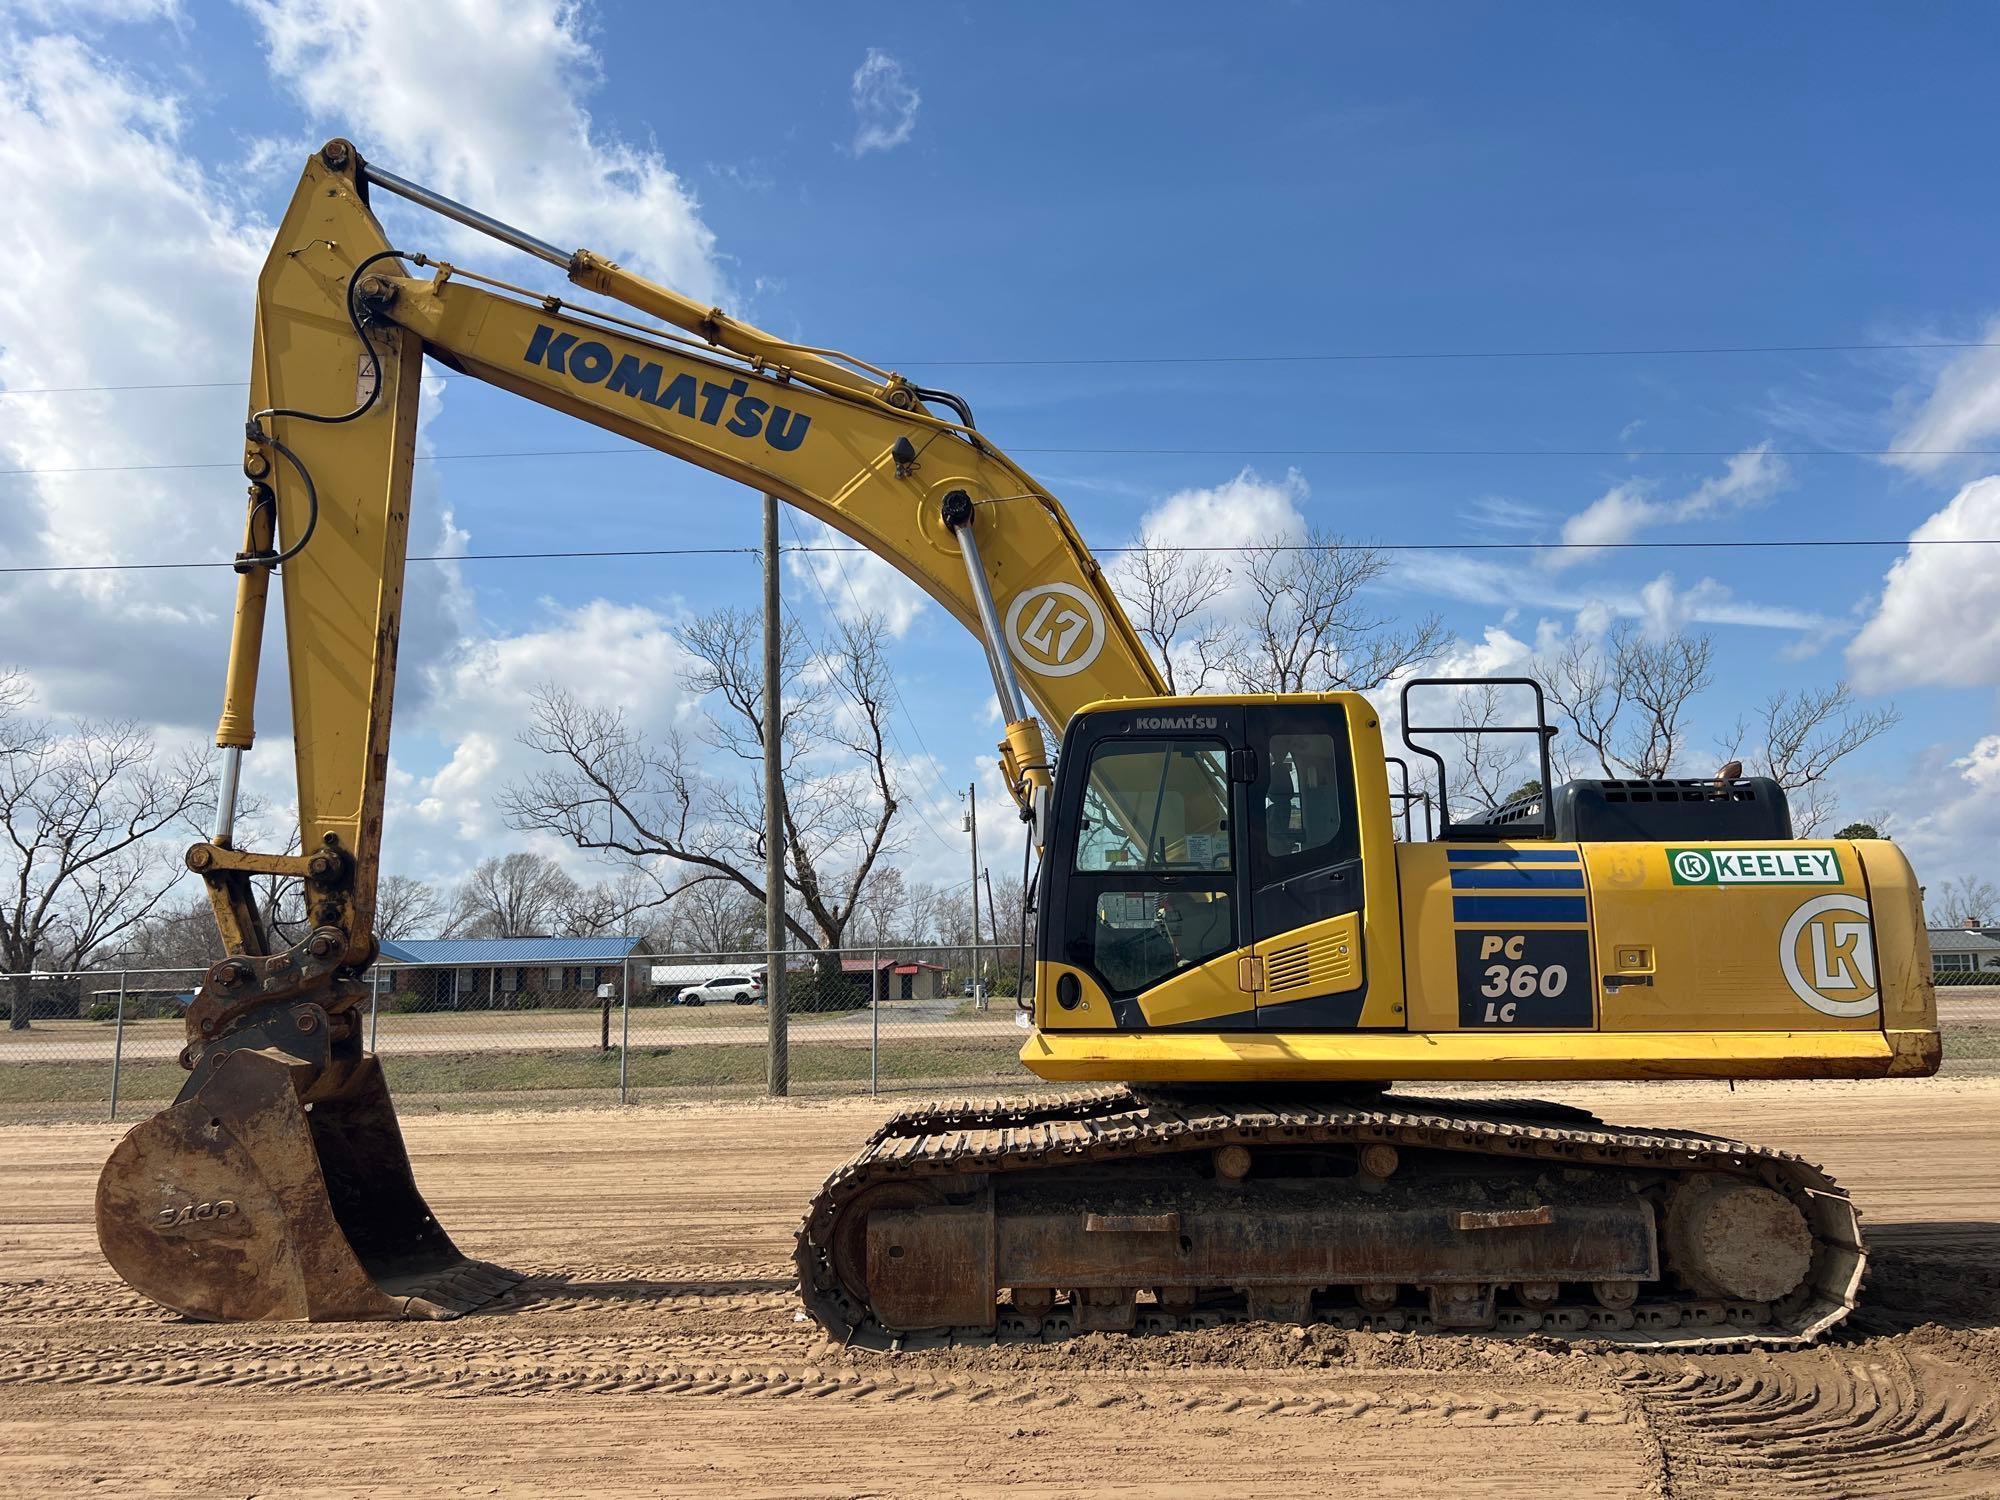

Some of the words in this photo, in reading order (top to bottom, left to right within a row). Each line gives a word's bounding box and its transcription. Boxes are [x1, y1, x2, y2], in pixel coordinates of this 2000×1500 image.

[524, 324, 812, 451] KOMATSU
[1136, 714, 1218, 730] KOMATSU
[1716, 855, 1830, 877] KEELEY
[1479, 935, 1526, 960] PC
[1481, 964, 1568, 998] 360
[1484, 1002, 1517, 1023] LC
